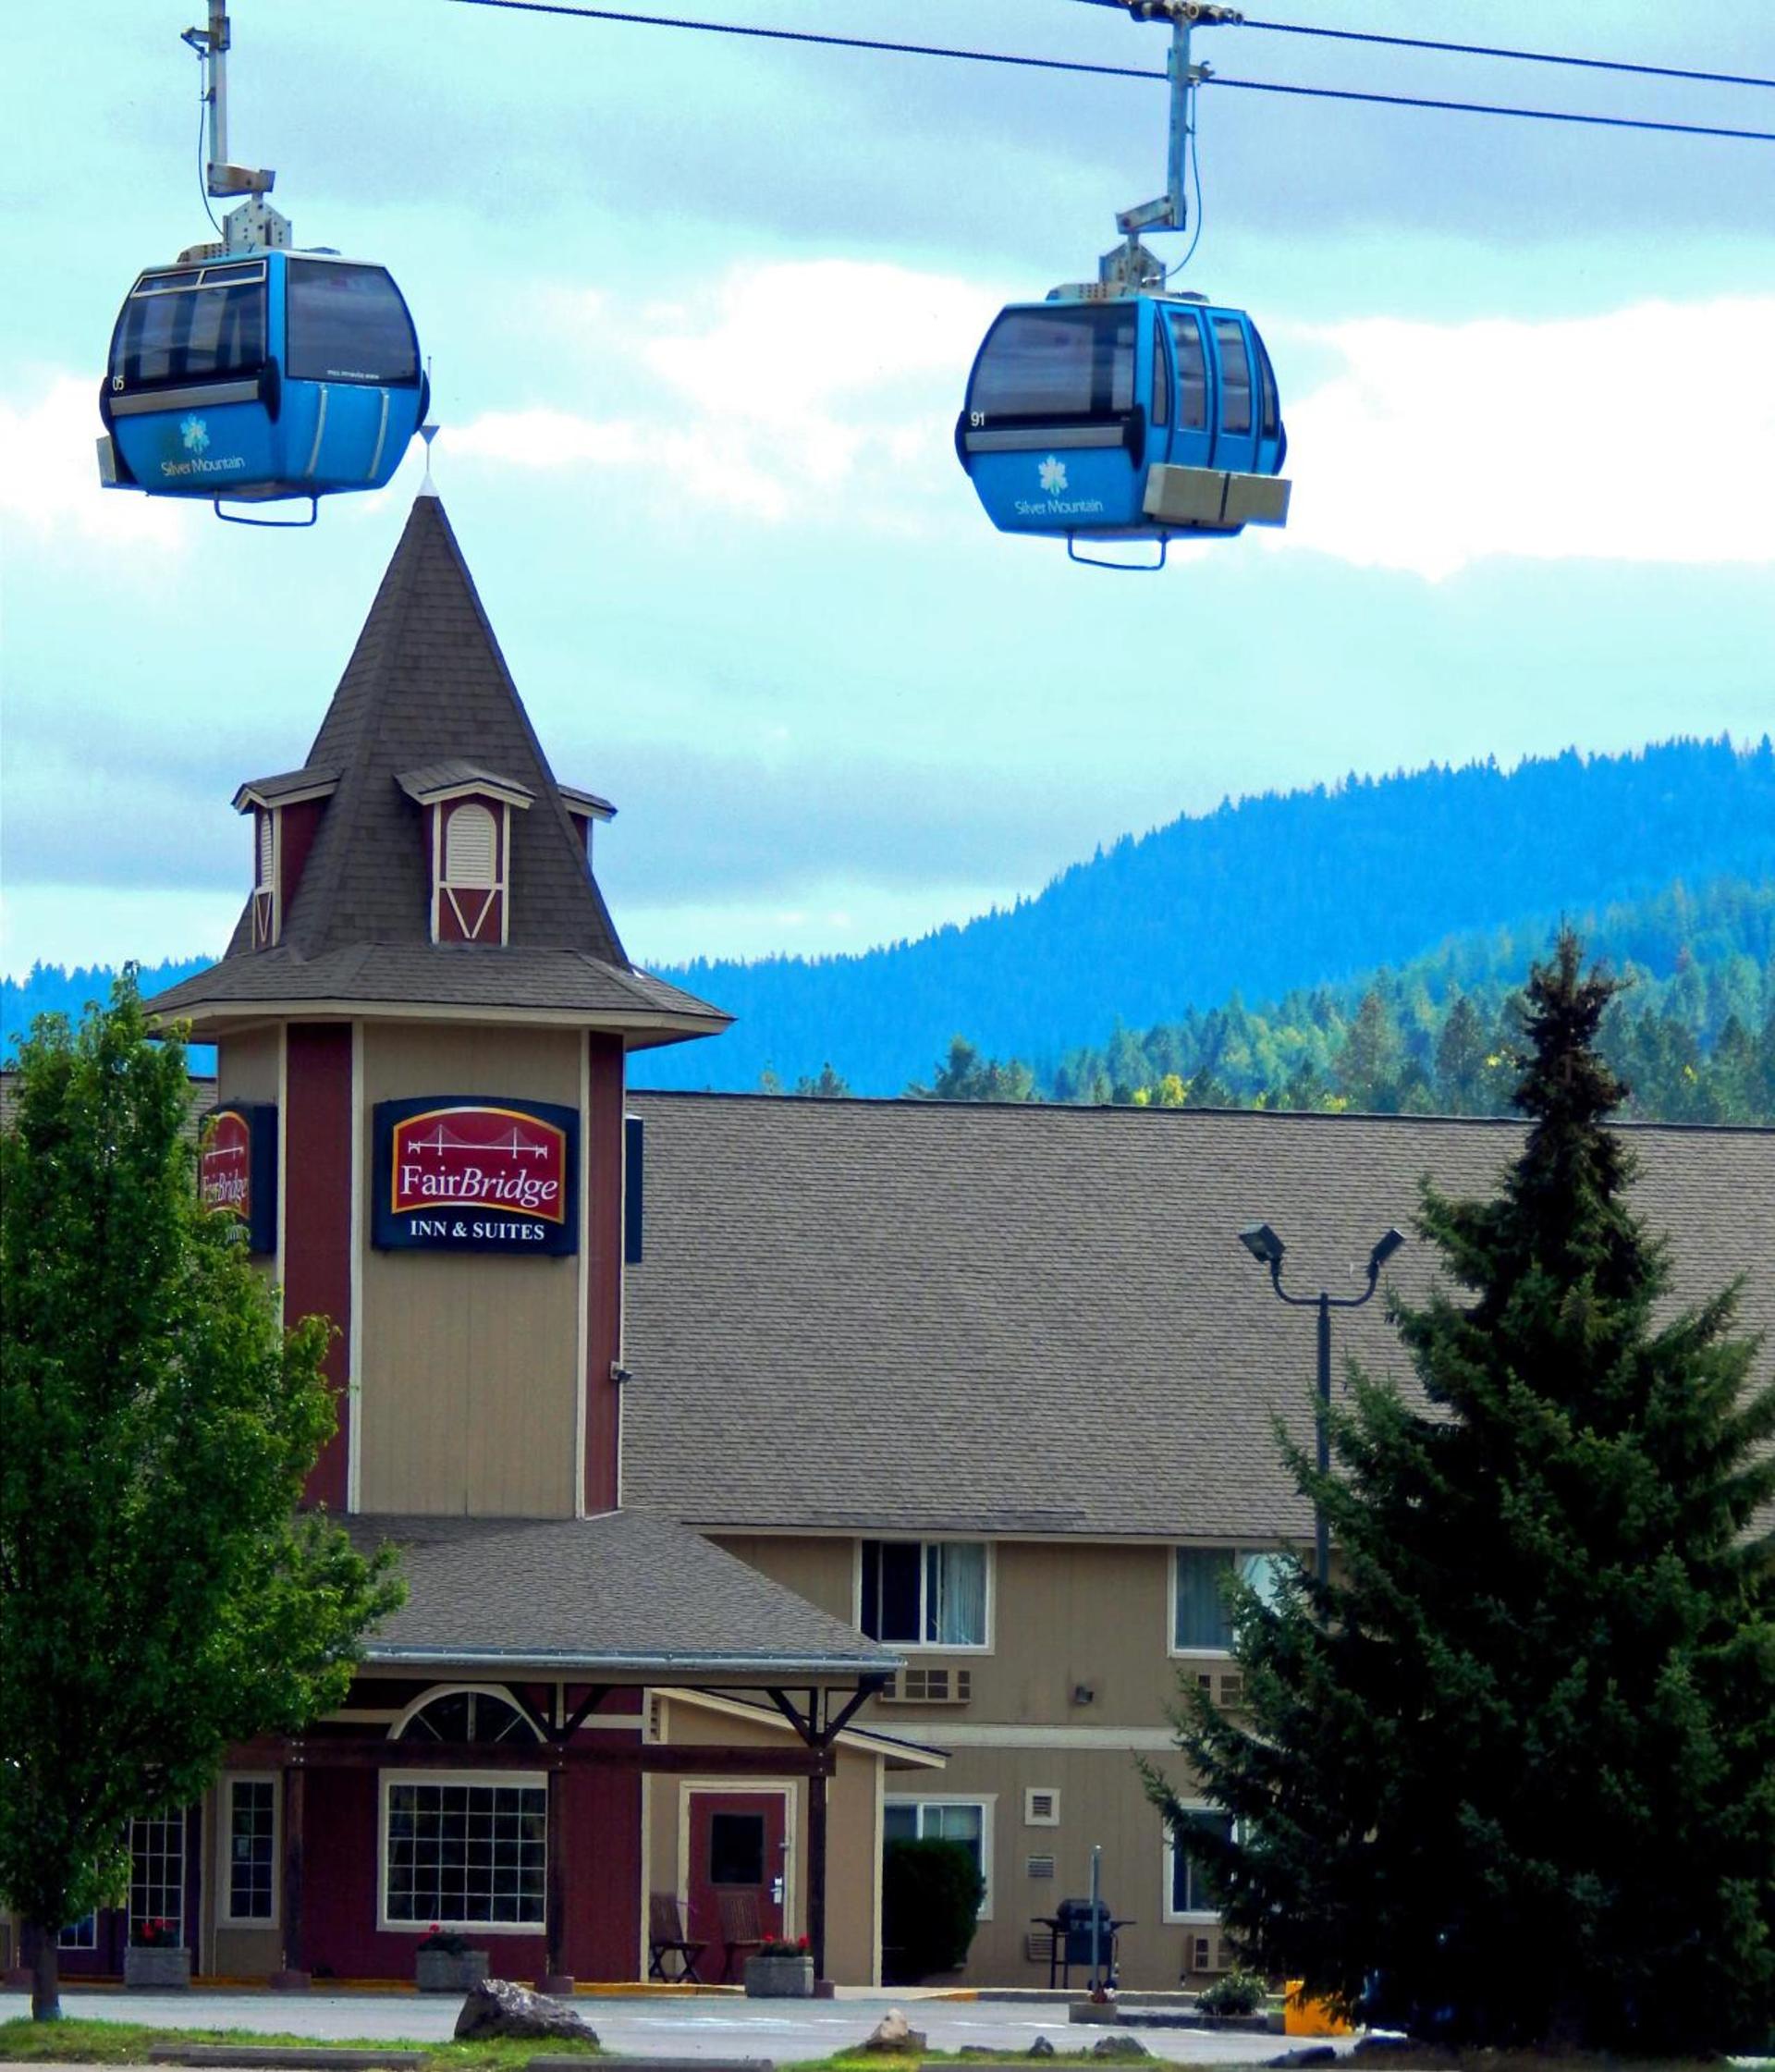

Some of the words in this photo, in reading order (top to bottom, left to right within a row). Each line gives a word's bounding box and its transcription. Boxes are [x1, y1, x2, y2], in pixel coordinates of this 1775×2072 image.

[112, 375, 125, 391] 05
[971, 411, 985, 426] 91
[161, 460, 190, 476] Silver
[191, 457, 245, 472] Mountain
[1014, 499, 1046, 515] Silver
[1047, 499, 1104, 514] Mountain
[400, 1165, 558, 1208] FairBridge
[410, 1220, 447, 1237] INN
[452, 1221, 468, 1238] &
[472, 1222, 545, 1241] SUITES
